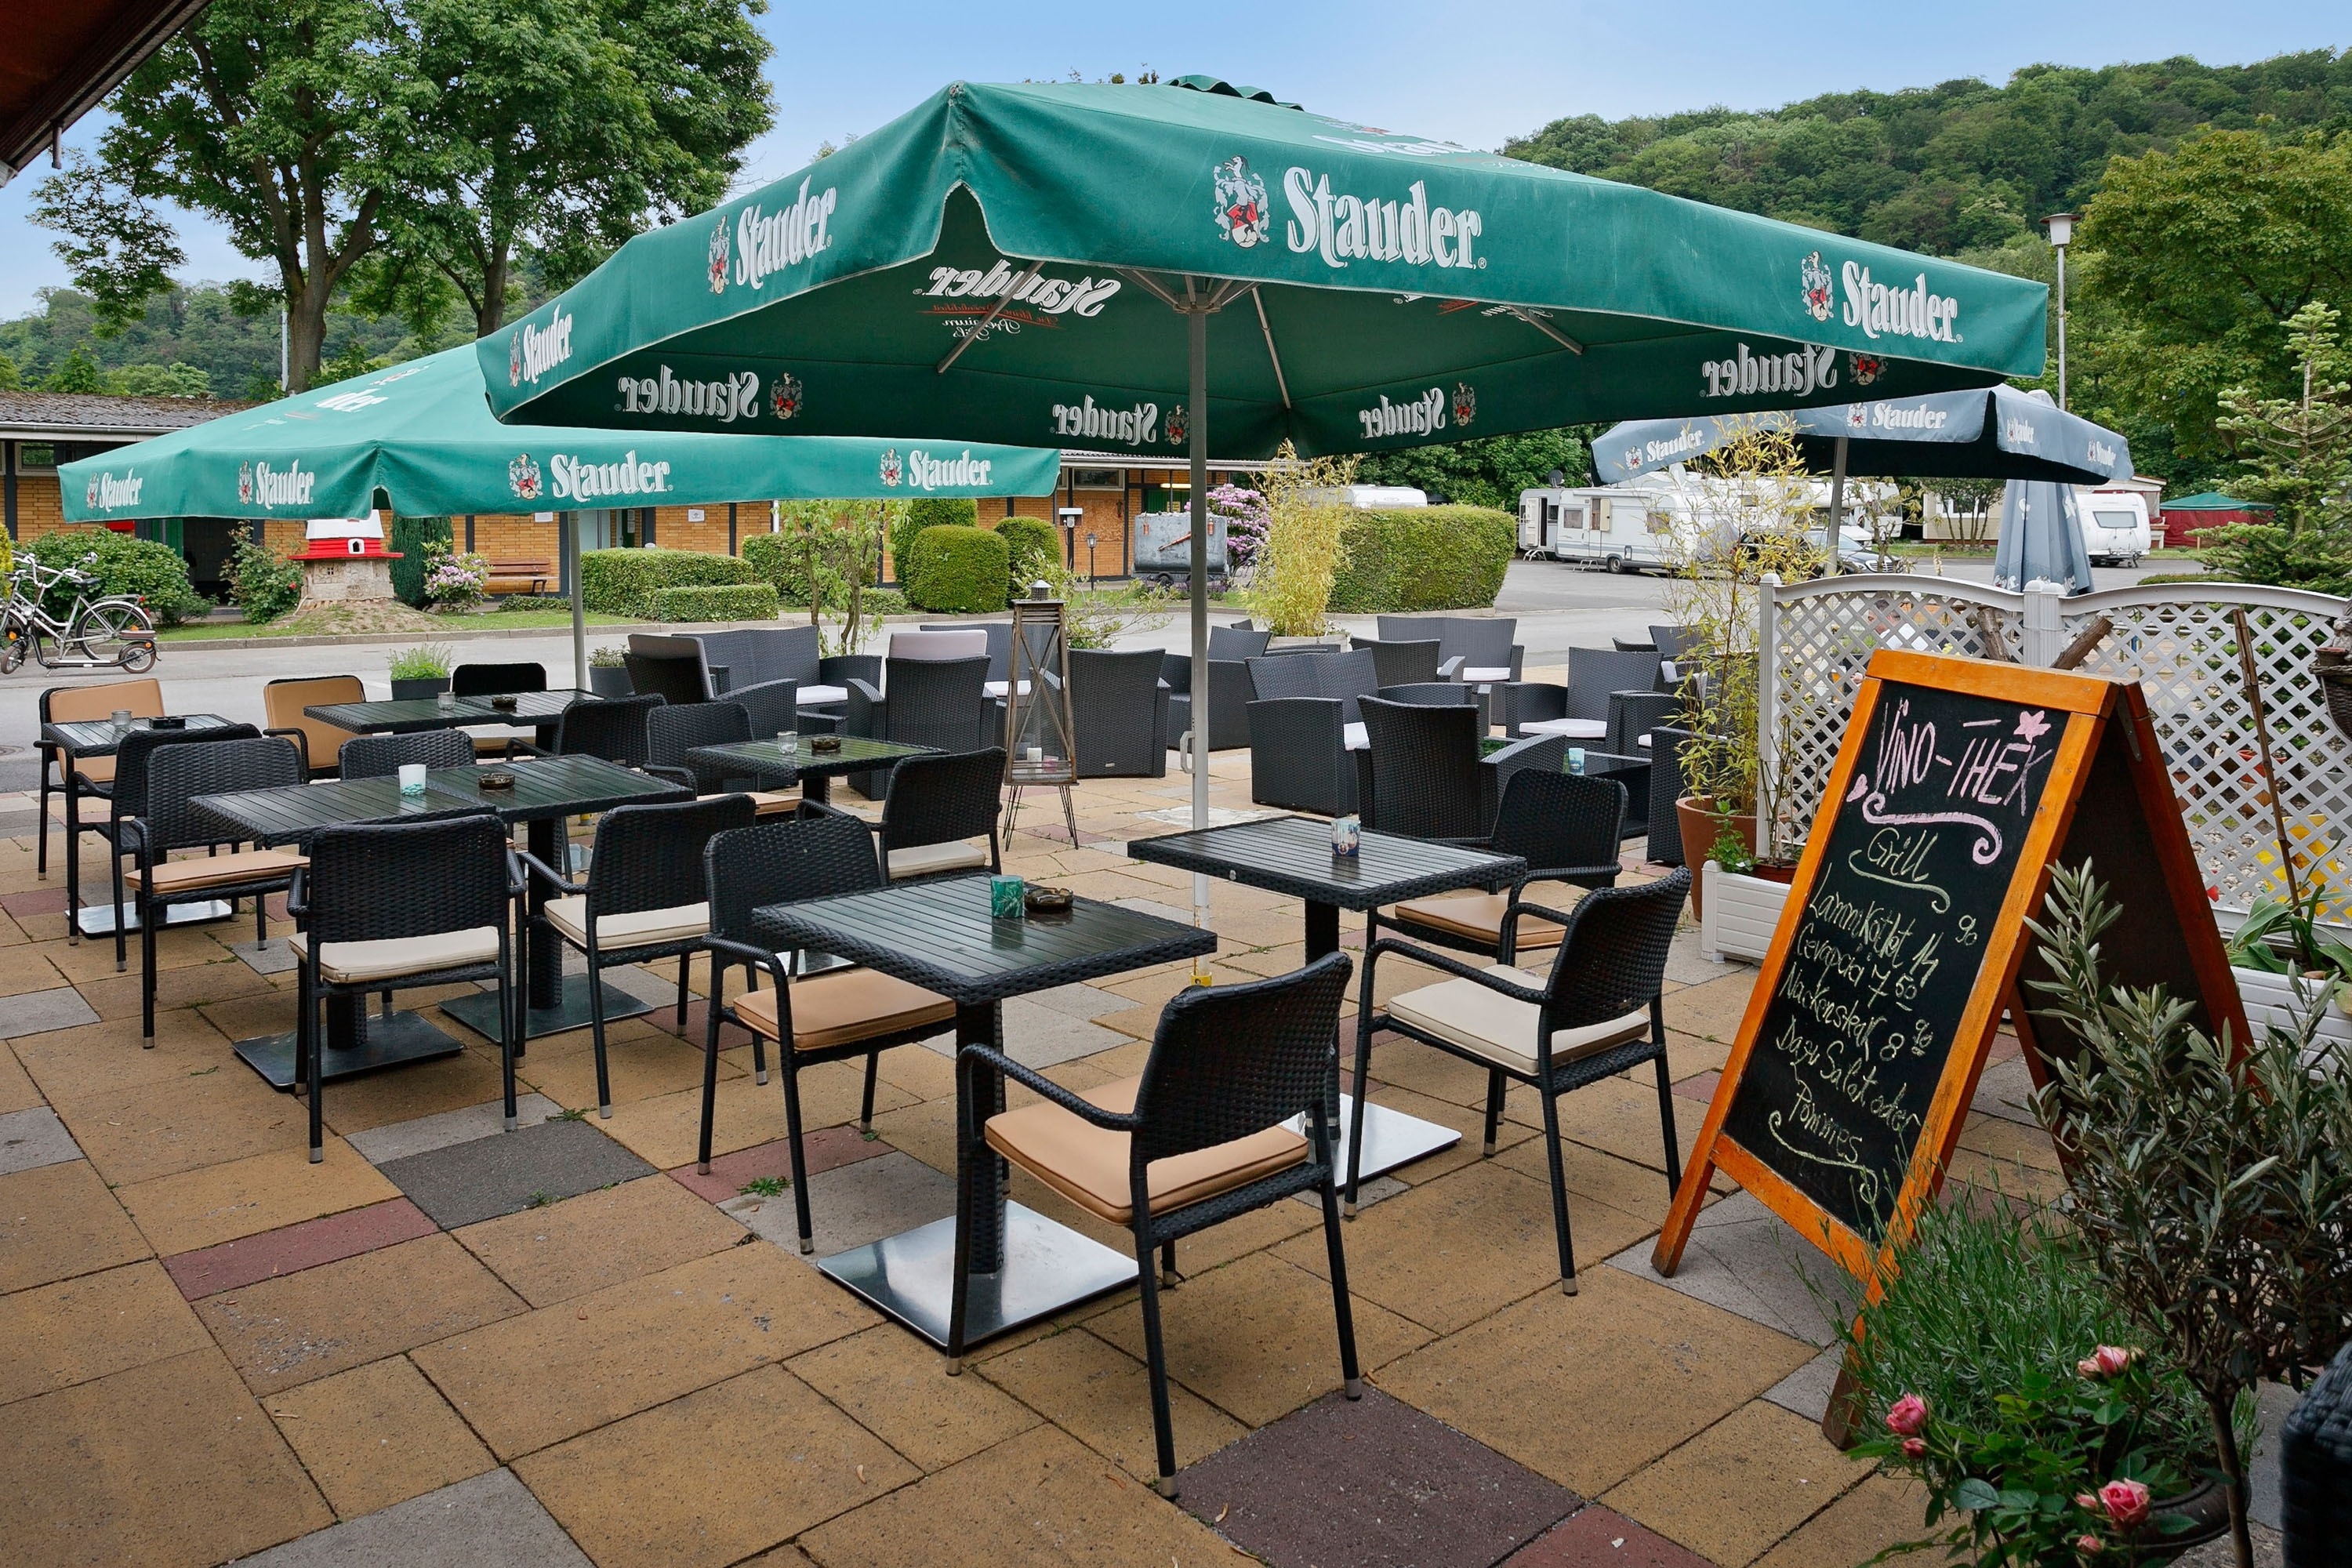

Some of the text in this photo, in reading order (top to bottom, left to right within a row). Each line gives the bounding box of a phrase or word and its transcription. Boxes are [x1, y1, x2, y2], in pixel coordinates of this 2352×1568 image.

[735, 175, 837, 291] Stauder
[1283, 166, 1483, 270] Stauder
[1842, 260, 1958, 343] Stauder
[523, 303, 573, 386] Stauder
[1872, 402, 1947, 430] Stauder
[909, 449, 992, 492] Stauder
[1646, 429, 1704, 463] Stauder
[99, 467, 143, 513] Stauder
[256, 459, 314, 510] Stauder
[550, 450, 671, 502] Stauder
[1867, 827, 1938, 882] Grill
[1879, 1032, 1905, 1062] 8
